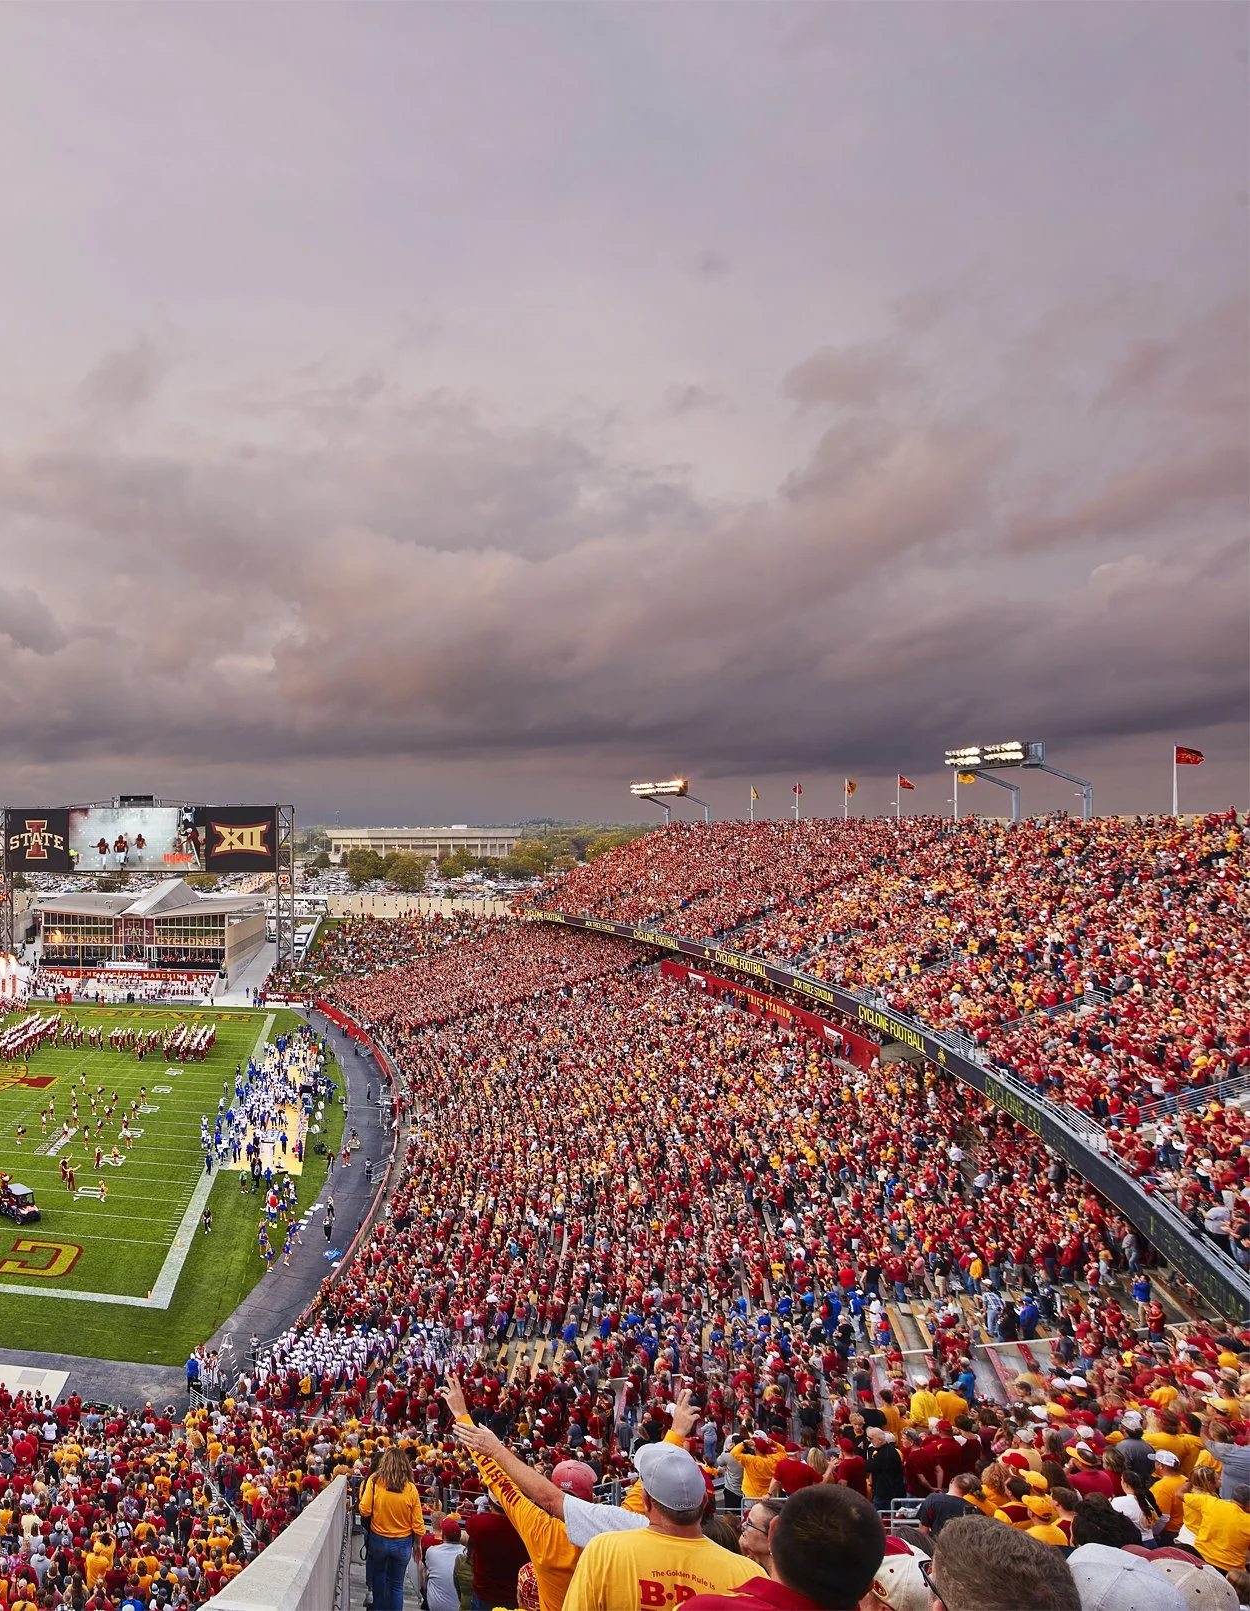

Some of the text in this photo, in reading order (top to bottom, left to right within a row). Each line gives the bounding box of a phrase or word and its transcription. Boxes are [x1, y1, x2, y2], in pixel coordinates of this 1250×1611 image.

[10, 832, 64, 851] STATE
[78, 935, 111, 944] STATE
[156, 937, 221, 946] CYCLONES
[633, 929, 680, 950] CYCLONE FOOTBALL
[715, 951, 767, 978] CYCLONE FOOTBALL
[858, 1004, 927, 1054] CYCLONE FOOTBALL
[471, 1448, 502, 1481] STAT
[651, 1569, 716, 1590] The Golden Rule Is
